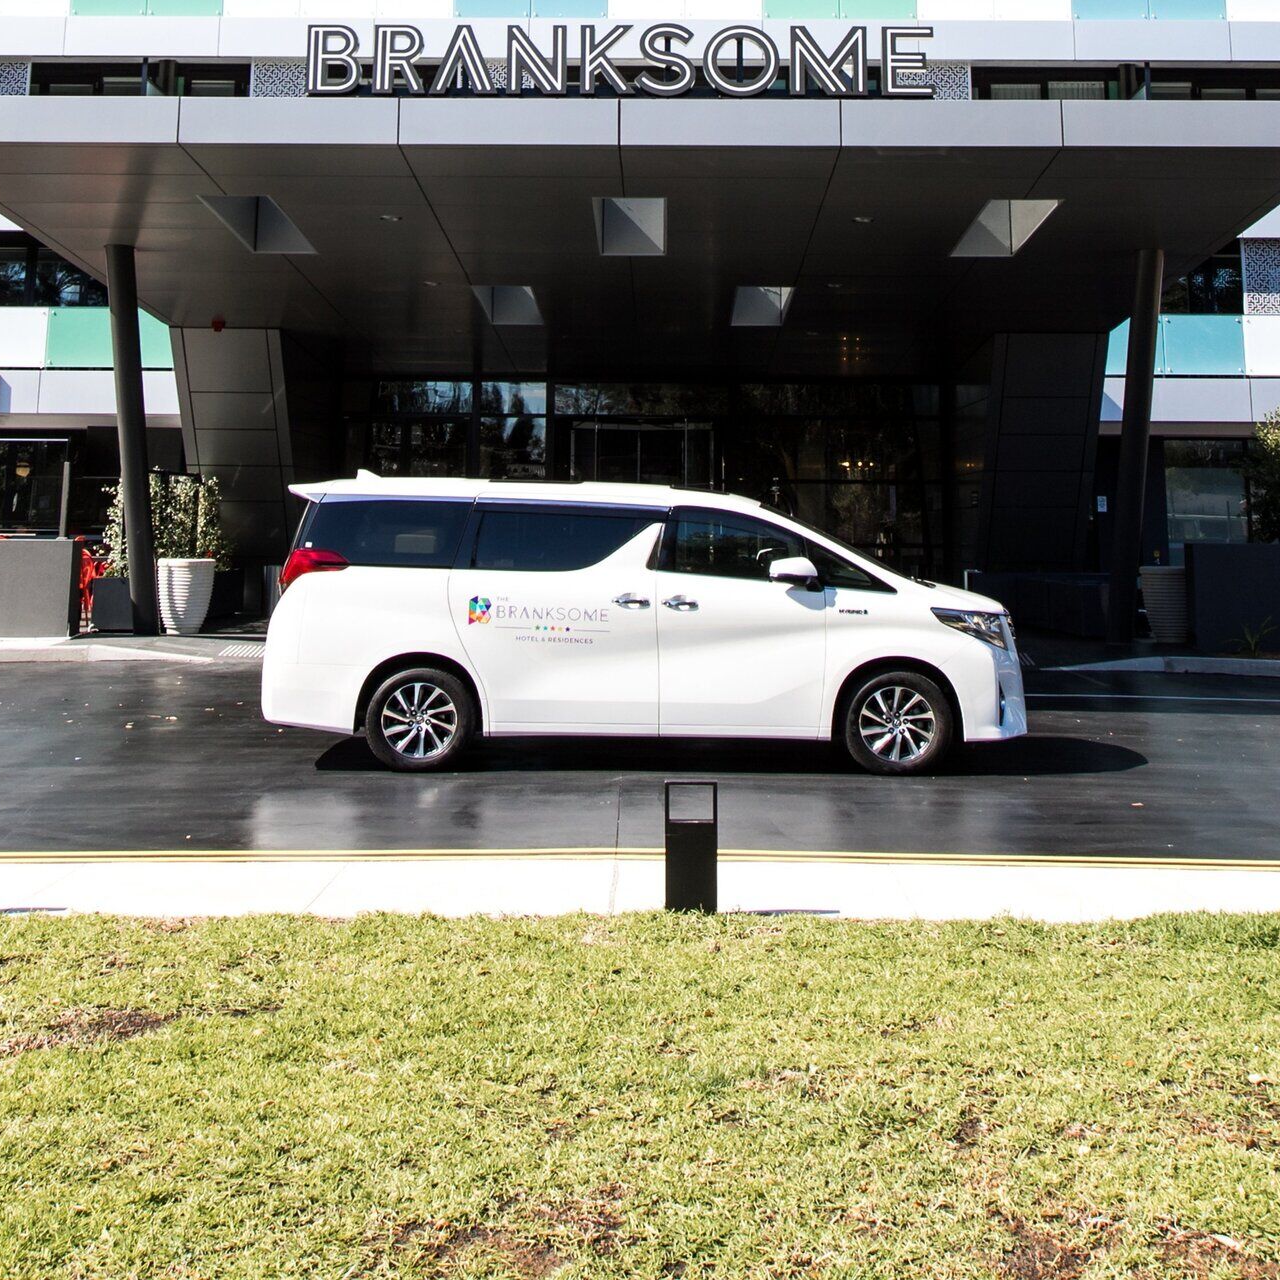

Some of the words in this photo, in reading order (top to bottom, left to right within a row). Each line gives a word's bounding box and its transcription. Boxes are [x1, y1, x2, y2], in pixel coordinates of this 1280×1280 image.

[306, 23, 934, 97] BRANKSOME
[496, 605, 609, 622] BRANKSOME
[547, 636, 593, 645] RESIDENCES
